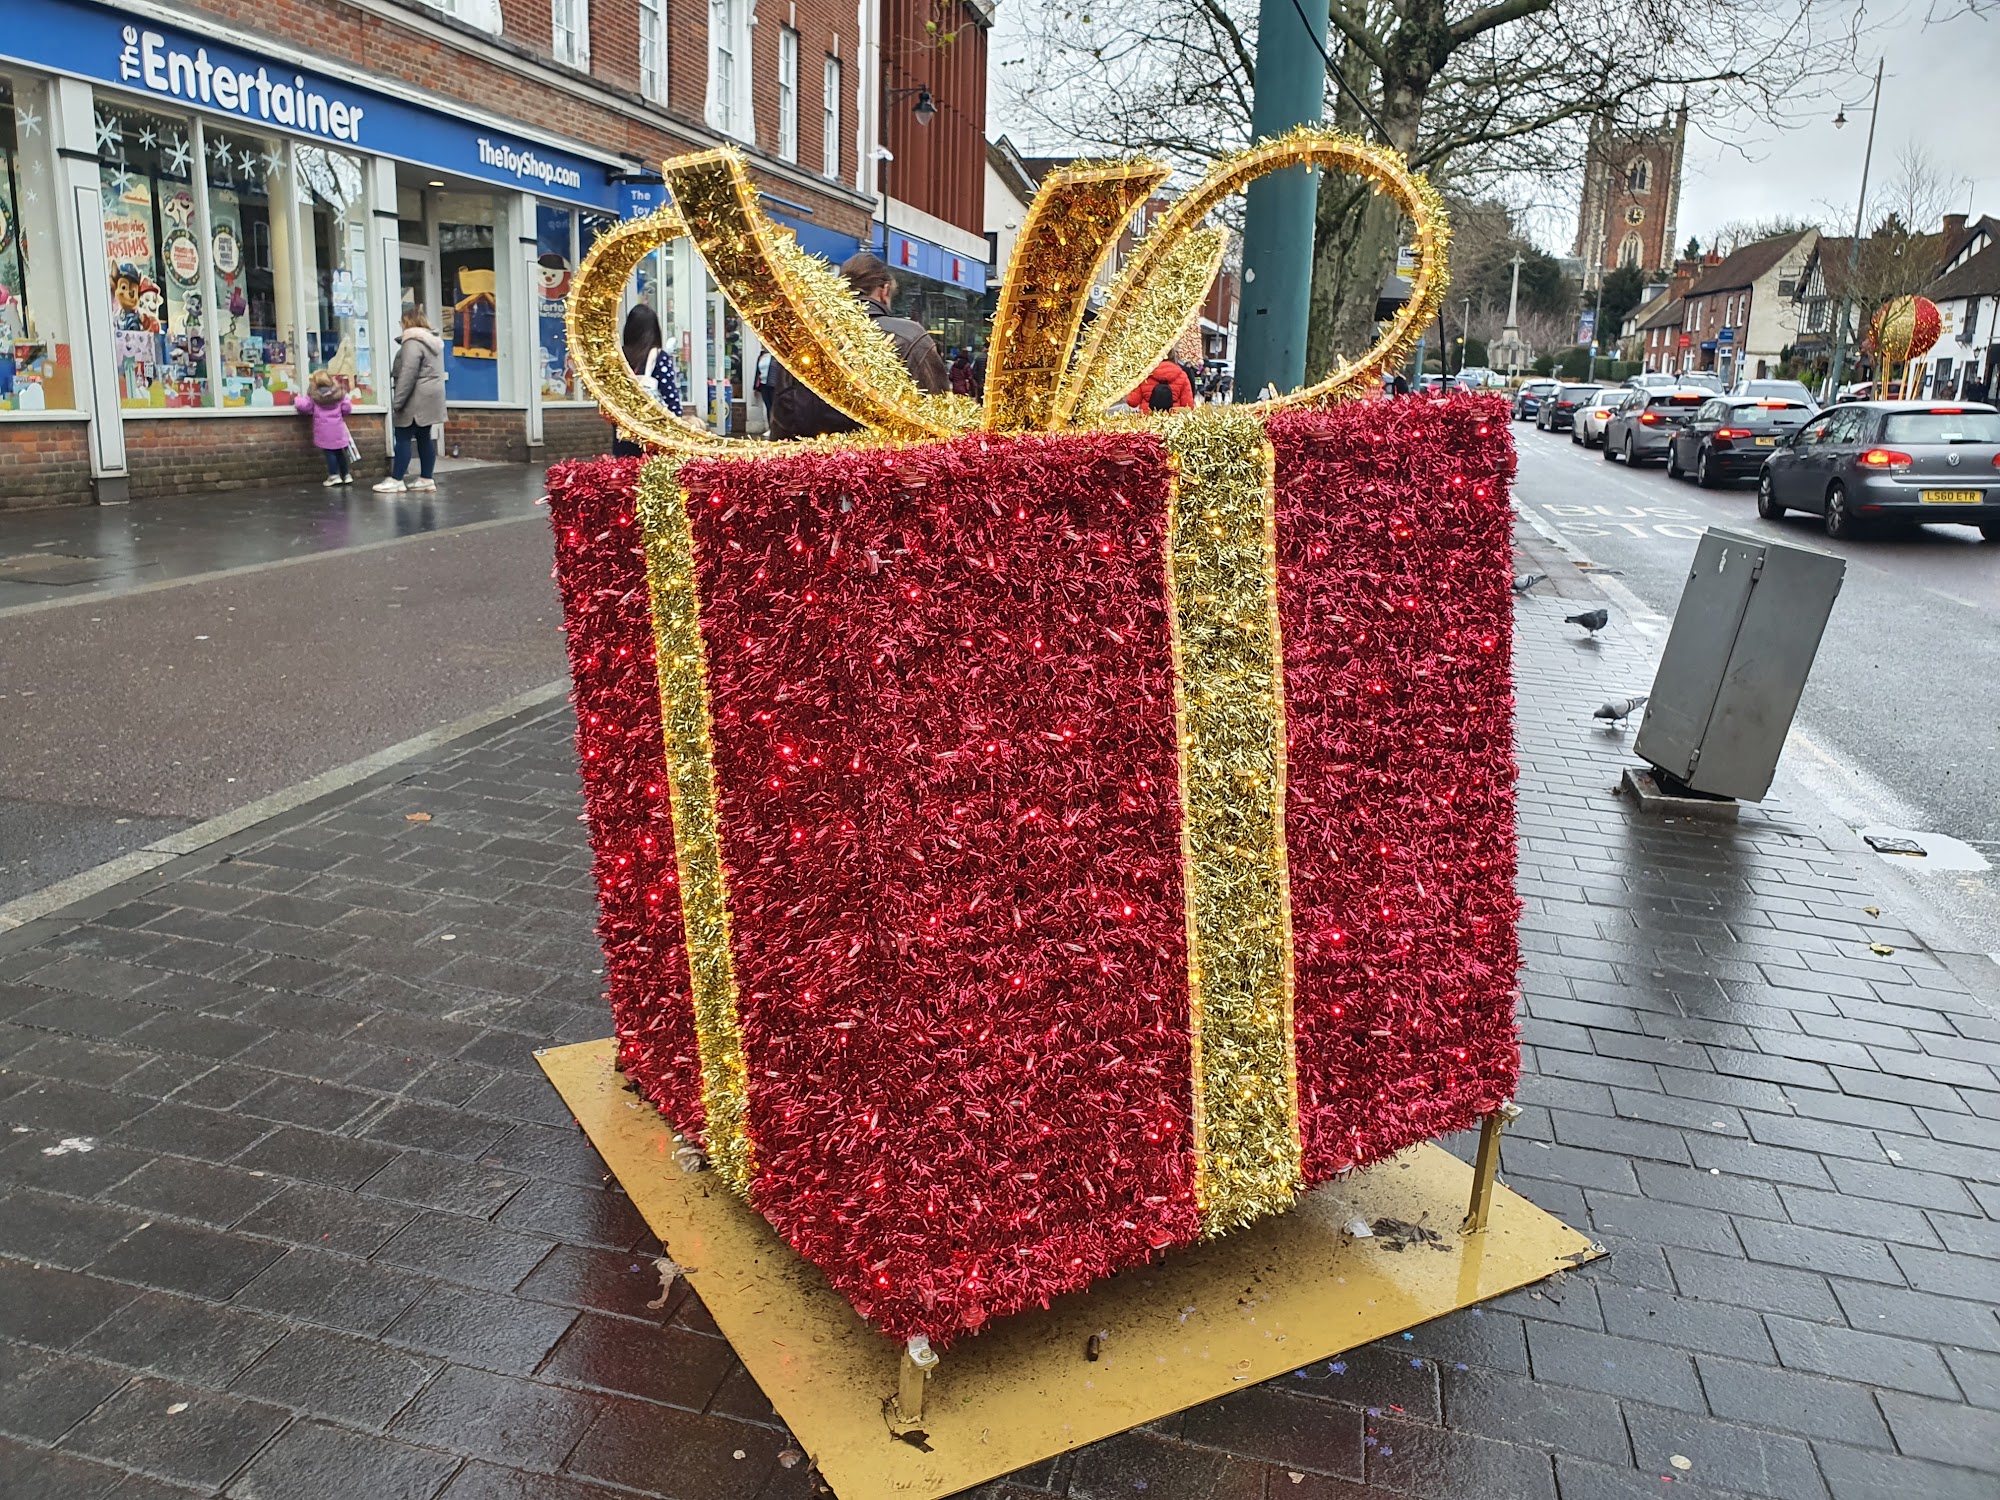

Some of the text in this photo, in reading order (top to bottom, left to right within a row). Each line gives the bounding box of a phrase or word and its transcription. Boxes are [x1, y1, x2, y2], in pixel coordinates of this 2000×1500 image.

[119, 25, 141, 81] The
[141, 30, 364, 143] Entertainer
[476, 138, 581, 189] TheToyShop.com
[630, 190, 651, 201] The
[631, 205, 651, 217] Toy
[1093, 287, 1100, 296] B
[1927, 490, 1976, 501] LS60 ETR
[1541, 503, 1703, 520] BUS
[1555, 521, 1712, 540] STO
